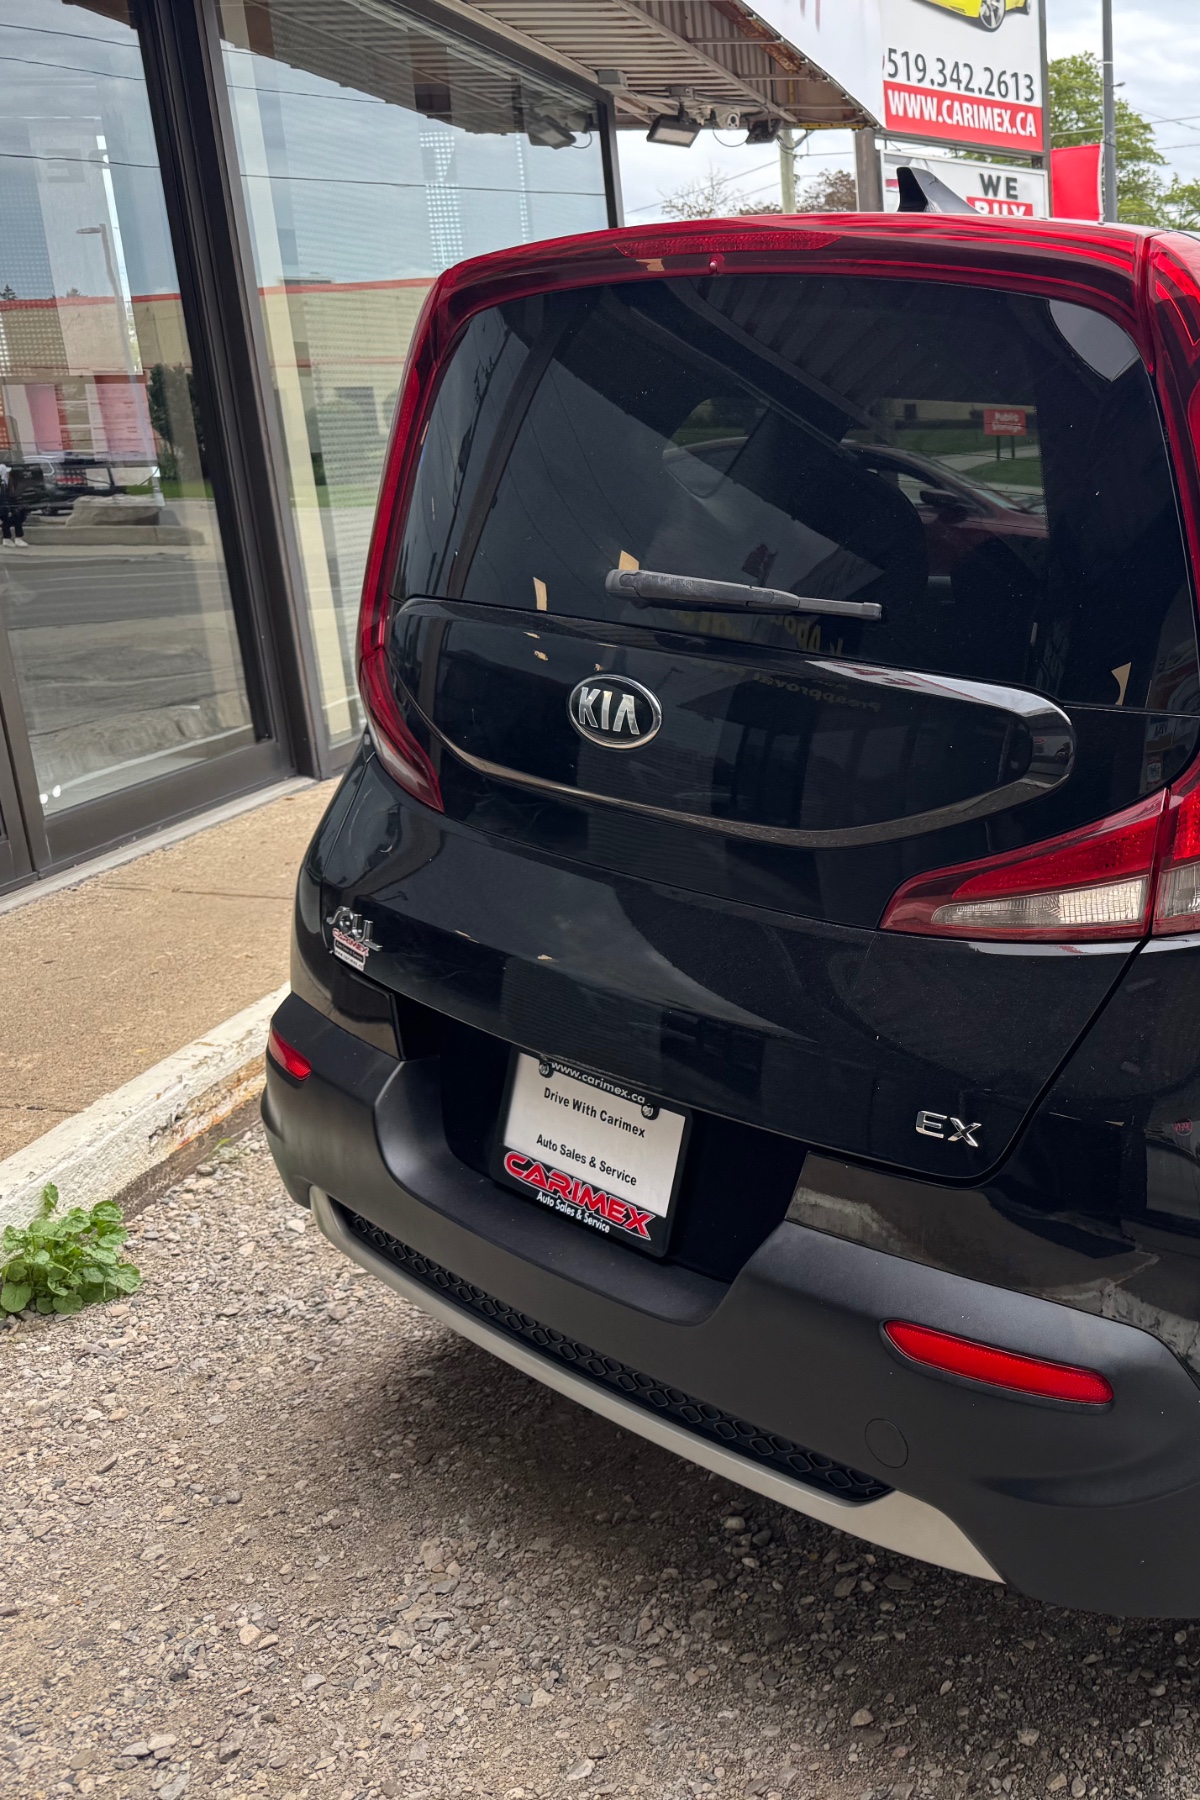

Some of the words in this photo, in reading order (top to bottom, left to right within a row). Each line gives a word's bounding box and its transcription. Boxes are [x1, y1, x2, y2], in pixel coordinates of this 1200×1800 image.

[888, 47, 1035, 102] 519.342.2613
[887, 89, 1037, 138] WWW.CARIMEX.CA
[979, 173, 1019, 200] WE
[579, 686, 641, 735] KIA
[326, 905, 384, 952] SOUL
[551, 1061, 646, 1103] www.carimex.ca
[544, 1087, 570, 1108] Drive
[572, 1098, 597, 1118] With
[600, 1110, 646, 1138] Carimex
[915, 1110, 982, 1148] EX
[536, 1133, 558, 1152] Auto
[559, 1144, 587, 1164] Sales
[588, 1156, 597, 1168] &
[599, 1160, 637, 1186] Service
[504, 1151, 656, 1241] CARIMEX
[536, 1191, 554, 1207] Auto
[555, 1198, 576, 1217] Sales
[575, 1209, 583, 1220] &
[584, 1212, 611, 1233] Service
